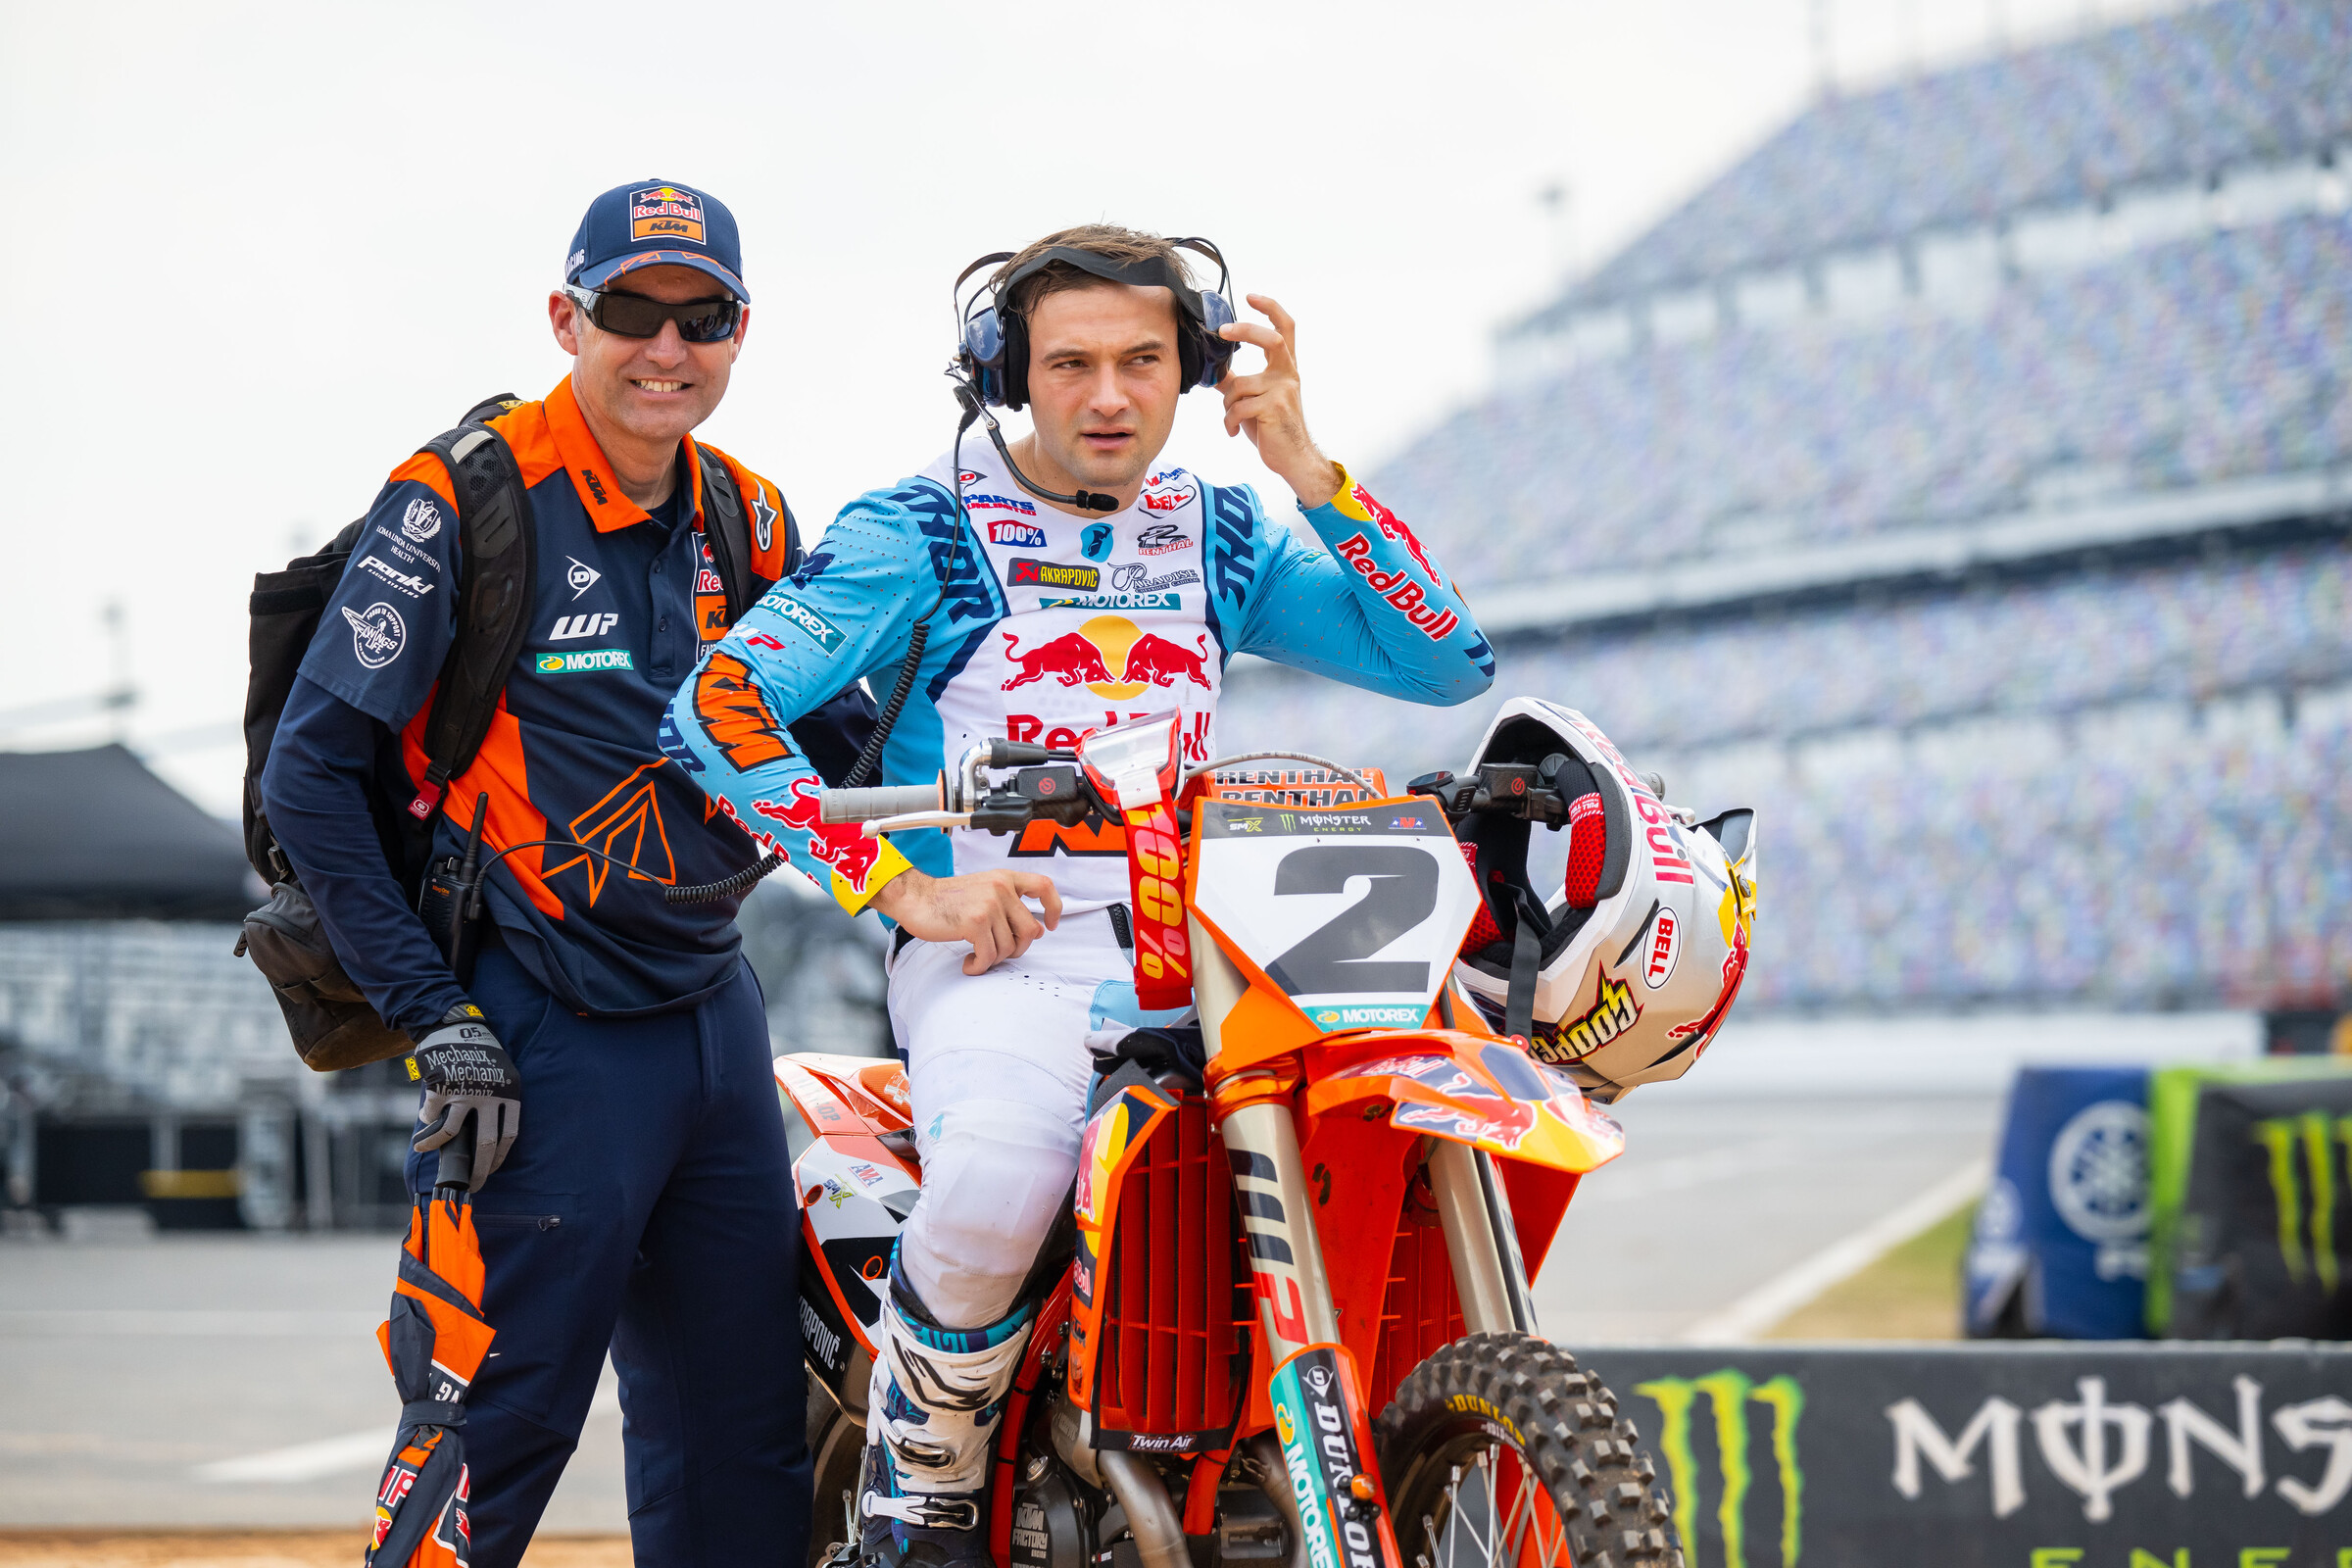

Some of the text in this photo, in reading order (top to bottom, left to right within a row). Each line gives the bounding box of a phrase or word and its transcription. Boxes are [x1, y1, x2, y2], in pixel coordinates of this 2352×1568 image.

[633, 202, 702, 222] Red Bull
[649, 220, 689, 233] KTM
[581, 469, 608, 506] KTM
[963, 494, 1036, 512] PARTS
[967, 503, 1037, 516] UNLIMITED
[1145, 494, 1190, 512] BELL
[375, 524, 392, 539] LOMA
[391, 533, 406, 548] LINDA
[993, 523, 1042, 546] 100%
[391, 545, 416, 564] HEALTH
[1139, 538, 1194, 556] RENTHAL
[1212, 485, 1255, 612] THO
[357, 555, 435, 595] Pankl
[1337, 532, 1459, 642] Red Bull
[1079, 591, 1172, 610] MOTOREX
[549, 612, 619, 641] WP
[566, 650, 632, 670] MOTOREX
[692, 648, 797, 774] KTM
[1229, 819, 1263, 832] SMX
[1299, 813, 1372, 826] MONSTER
[1389, 816, 1427, 829] AMA
[1634, 794, 1694, 885] Bull
[1126, 804, 1188, 980] 100%
[1264, 845, 1440, 998] 2
[1648, 917, 1675, 980] BELL
[1343, 1007, 1419, 1023] MOTOREX
[424, 1045, 491, 1071] Mechanix
[443, 1061, 506, 1084] Mechanix
[850, 1163, 884, 1188] AMA
[823, 1178, 855, 1209] SMX
[1133, 1435, 1170, 1448] Twin
[1169, 1435, 1195, 1448] Air
[1016, 1501, 1045, 1531] KTM
[1012, 1528, 1049, 1549] FACTORY
